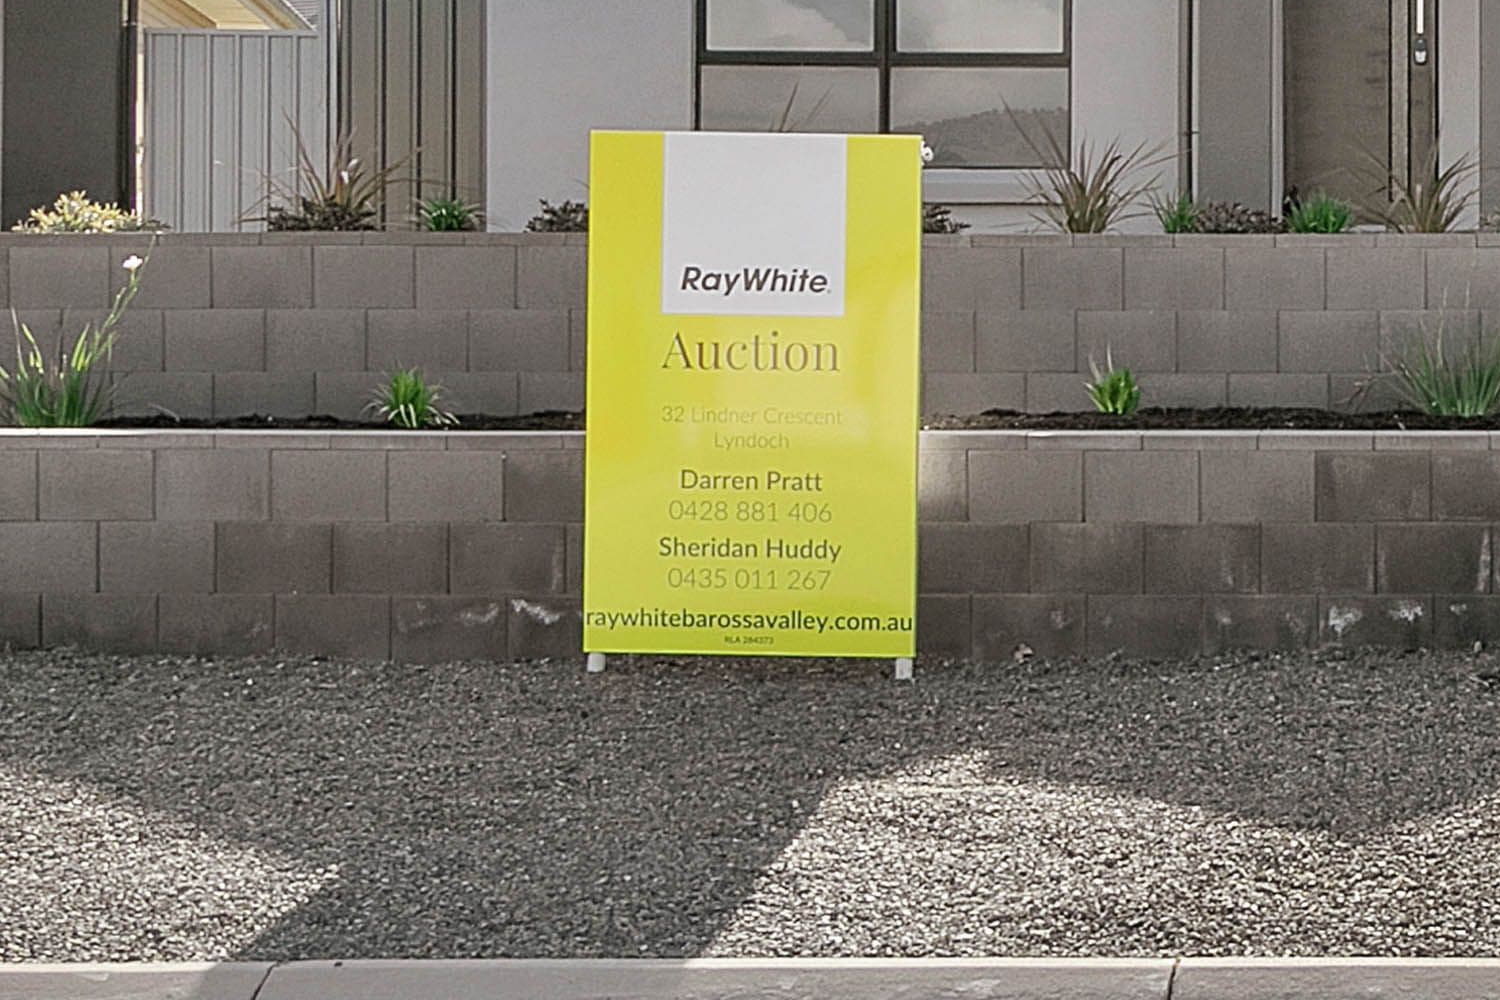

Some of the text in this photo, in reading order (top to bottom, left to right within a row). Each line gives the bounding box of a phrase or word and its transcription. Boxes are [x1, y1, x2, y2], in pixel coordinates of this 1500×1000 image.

[681, 266, 828, 297] RayWhite
[661, 330, 841, 373] Auction
[661, 405, 842, 425] 32 Lindner Crescent
[714, 432, 790, 451] Lyndoch
[680, 469, 823, 491] Darren Pratt
[668, 500, 832, 523] 0428 881 406
[659, 537, 842, 563] Sheridan Huddy
[667, 567, 832, 591] 0435 011 267
[586, 608, 913, 634] raywhitebarossavalley.com.au
